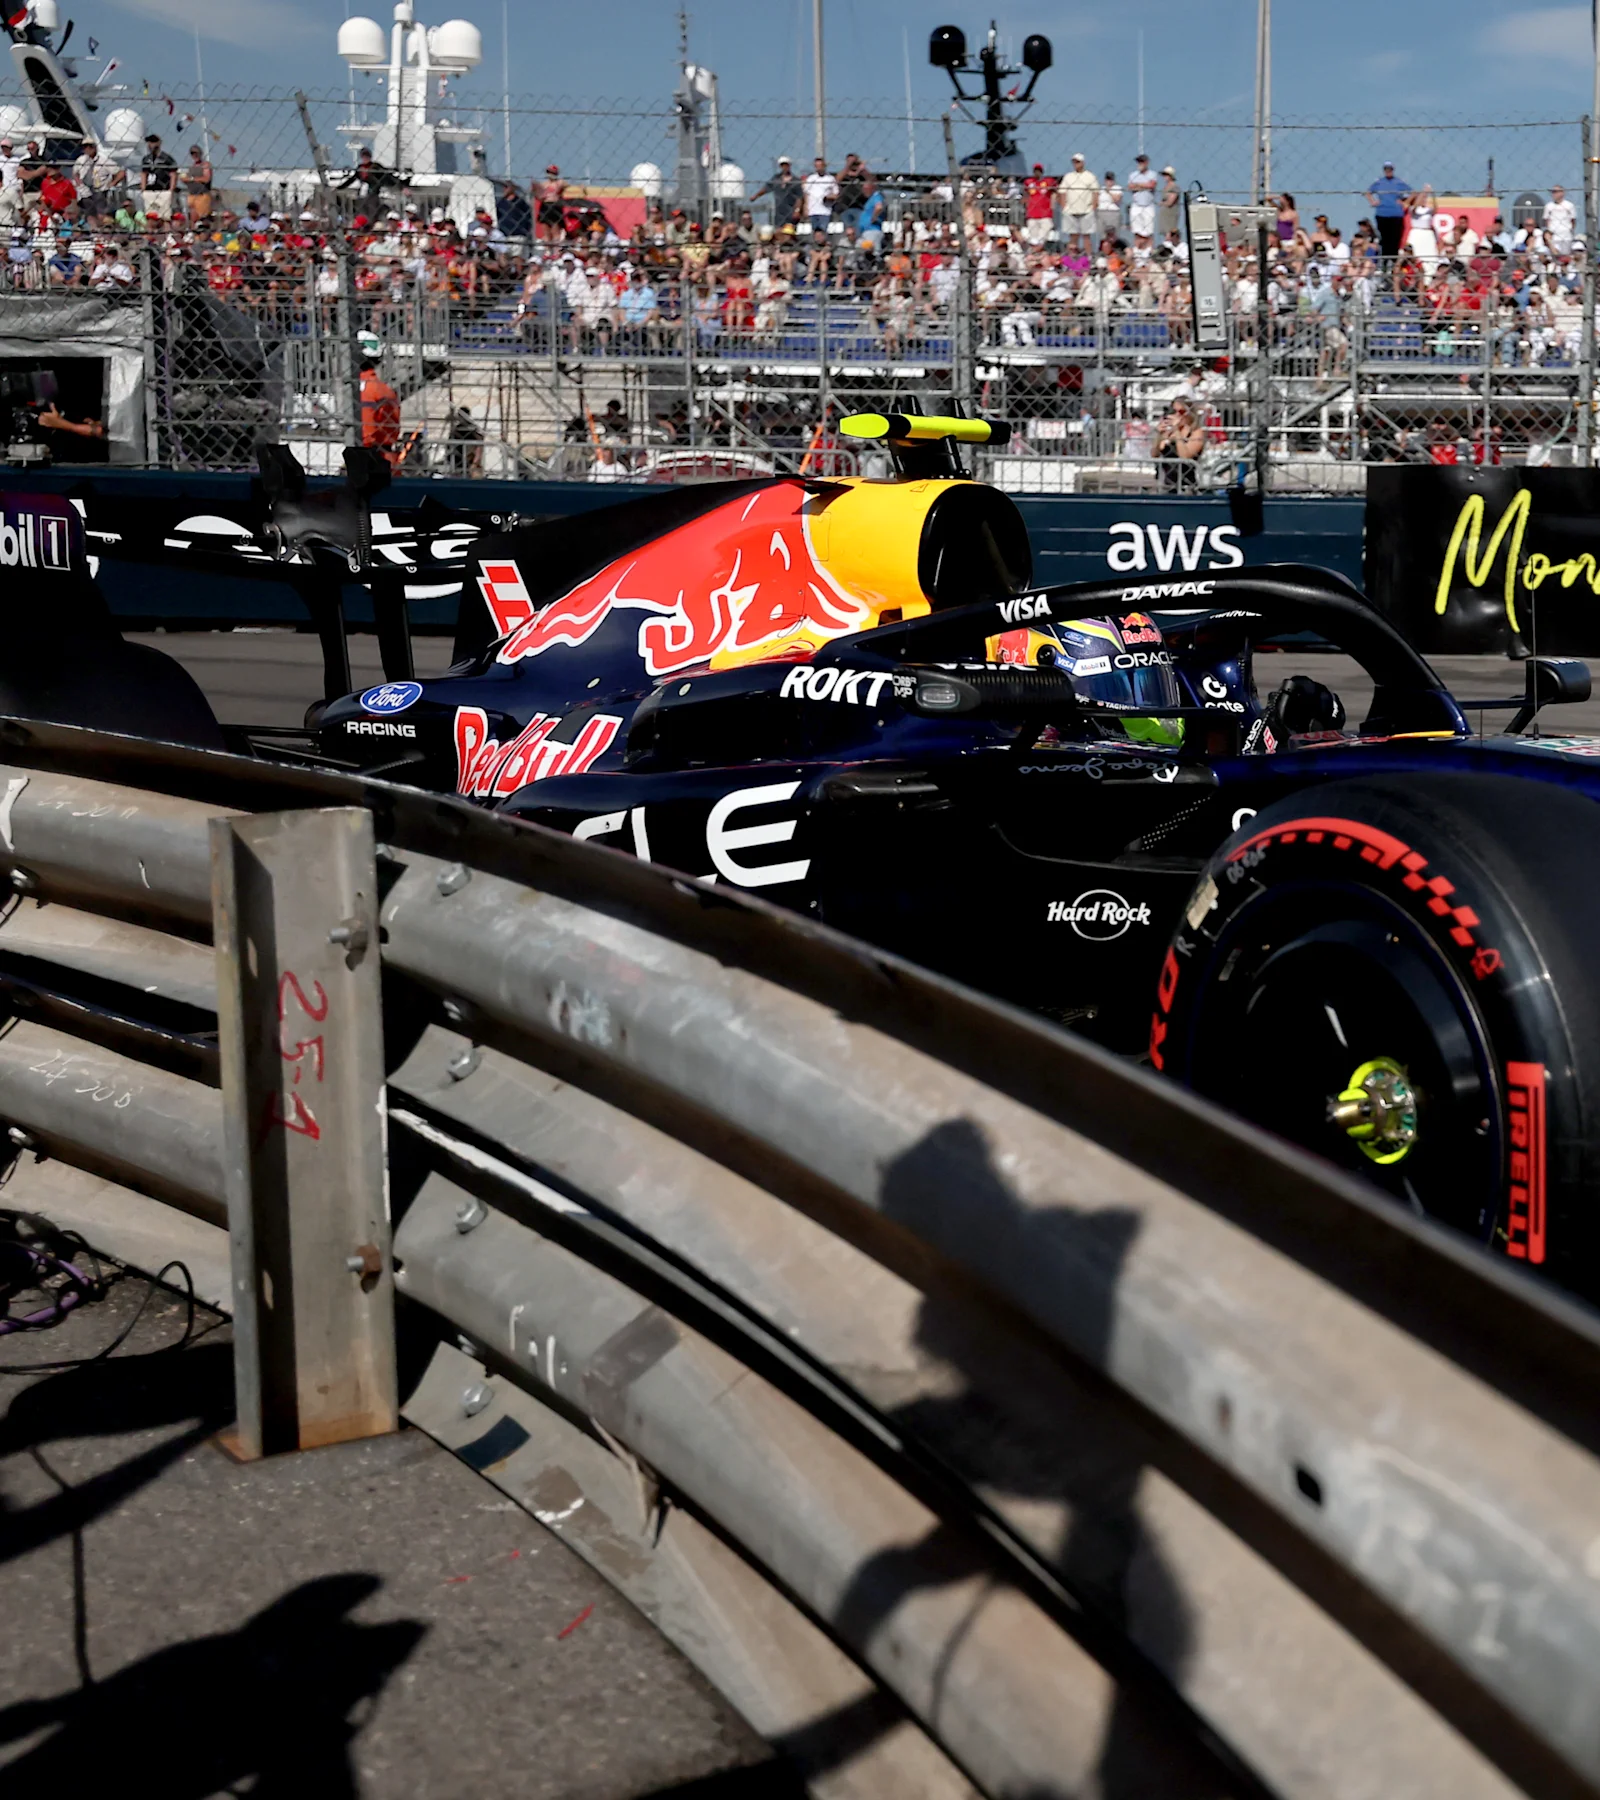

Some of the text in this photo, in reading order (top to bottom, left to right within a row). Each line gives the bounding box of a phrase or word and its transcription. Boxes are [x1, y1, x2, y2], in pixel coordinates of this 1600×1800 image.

[1107, 522, 1244, 571] aws
[1122, 580, 1216, 602] DAMAC
[995, 594, 1052, 623] VISA
[367, 685, 409, 707] Ford
[780, 666, 893, 707] ROKT
[346, 721, 416, 738] RACING
[1047, 901, 1151, 925] Hard Rock
[1506, 1061, 1546, 1265] PIRELLI
